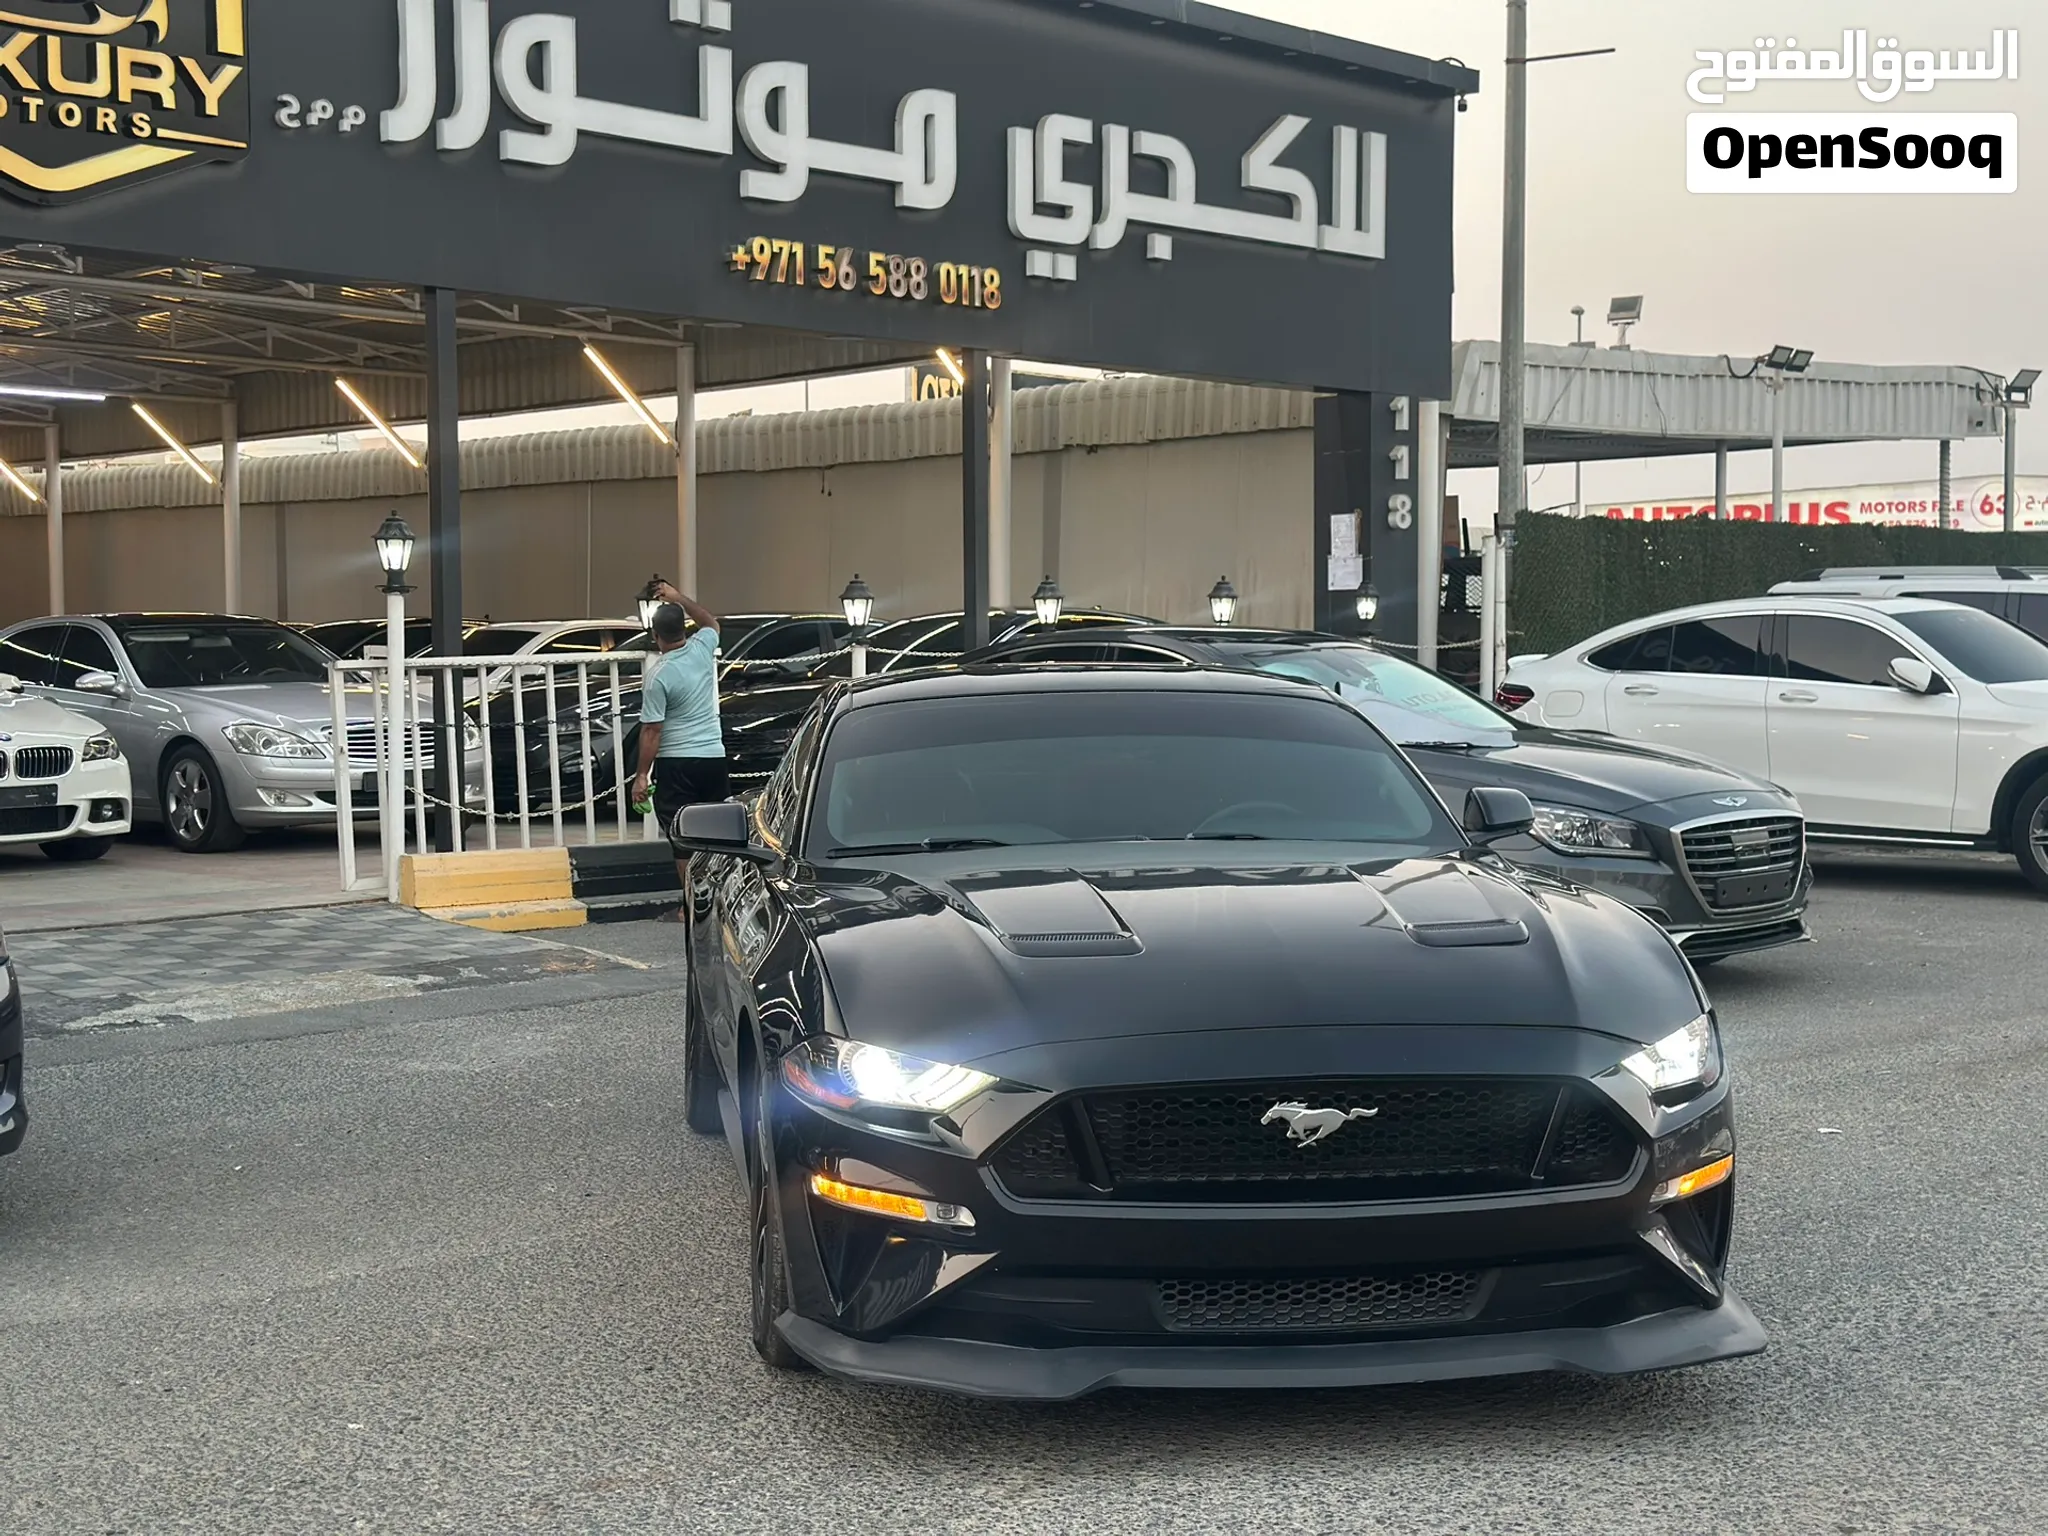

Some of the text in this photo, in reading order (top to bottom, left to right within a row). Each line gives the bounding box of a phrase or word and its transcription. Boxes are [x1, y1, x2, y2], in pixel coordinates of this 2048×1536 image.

[1007, 113, 1387, 281] لاكجري
[730, 235, 1002, 310] +971 56 588 0118
[1859, 500, 1927, 514] MOTORS
